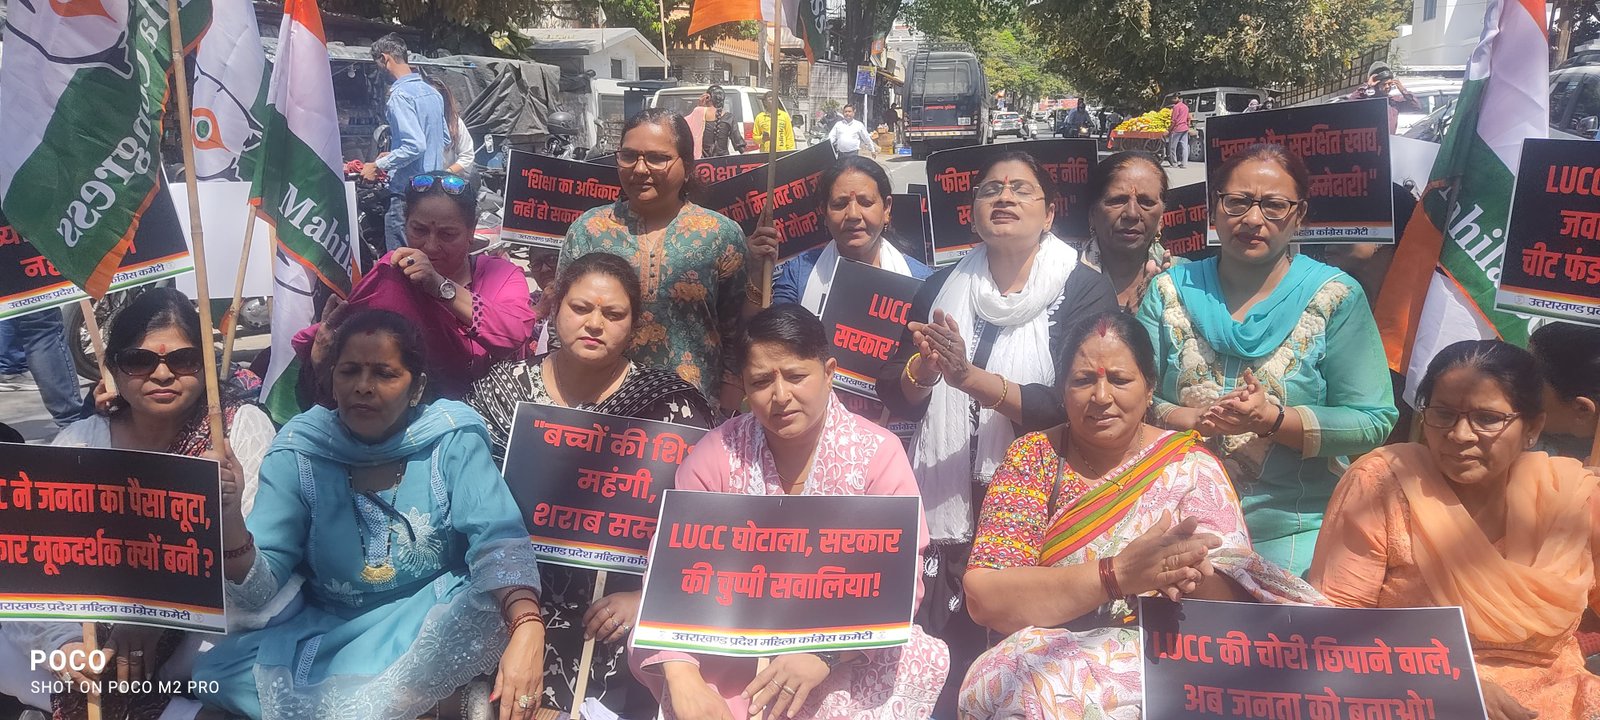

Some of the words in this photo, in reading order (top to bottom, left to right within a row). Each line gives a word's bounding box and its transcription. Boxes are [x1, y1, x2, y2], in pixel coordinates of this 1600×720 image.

[1289, 124, 1342, 157] सुरक्षित
[1344, 128, 1381, 156] खाद्य,
[522, 168, 557, 192] "शिक्षा
[558, 178, 574, 195] का
[575, 178, 621, 201] अधिकार
[1061, 157, 1088, 185] नीति
[1308, 166, 1377, 198] म्मेदारी!"
[512, 198, 538, 218] नहीं
[537, 200, 549, 220] हो
[746, 185, 793, 215] मिावट
[793, 178, 809, 198] का
[1316, 227, 1343, 236] कांग्रेस
[1345, 227, 1369, 236] कमेटी
[1438, 186, 1505, 289] hil
[1522, 241, 1562, 278] चीट
[8, 295, 52, 310] उत्तराखण्ड
[53, 286, 76, 300] प्रदेश
[138, 264, 165, 277] कमेटी
[869, 293, 912, 325] LUCC
[1529, 297, 1586, 314] उत्तराखण्ड
[834, 323, 894, 361] सरकार
[534, 419, 609, 454] "बच्चों
[611, 427, 648, 460] की
[10, 471, 32, 510] ने
[35, 481, 95, 513] जनता
[98, 483, 125, 515] का
[128, 478, 167, 519] पैसा
[169, 491, 212, 533] लूटा,
[578, 467, 656, 504] महंगी,
[533, 502, 605, 534] शराब
[31, 528, 123, 576] मूकदर्शक
[125, 533, 162, 571] क्यों
[163, 538, 199, 577] बनी
[568, 548, 593, 559] प्रदेश
[594, 551, 625, 563] महिला
[669, 523, 727, 551] LUCC
[732, 520, 813, 557] घोटाला,
[818, 528, 902, 553] सरकार
[681, 562, 714, 595] की
[715, 565, 767, 606] चुप्पी
[769, 566, 881, 599] सवालिया!
[48, 601, 77, 611] प्रदेश
[80, 601, 118, 613] महिला
[120, 602, 157, 616] कांग्रेस
[159, 606, 191, 621] कमेटी
[671, 631, 727, 646] उत्तराखण्ड
[730, 634, 758, 648] प्रदेश
[760, 634, 796, 647] महिला
[798, 633, 836, 646] कांग्रेस
[838, 630, 873, 643] कमेटी
[1153, 632, 1215, 664] LUCC
[1217, 631, 1251, 667] की
[1253, 633, 1308, 671] चोरी
[1312, 635, 1393, 675] छिपाने
[1394, 639, 1460, 680] वाले,
[1184, 684, 1224, 715] अब
[1227, 688, 1302, 720] जनता
[1304, 687, 1341, 720] को
[1343, 690, 1434, 720] बताओ!
